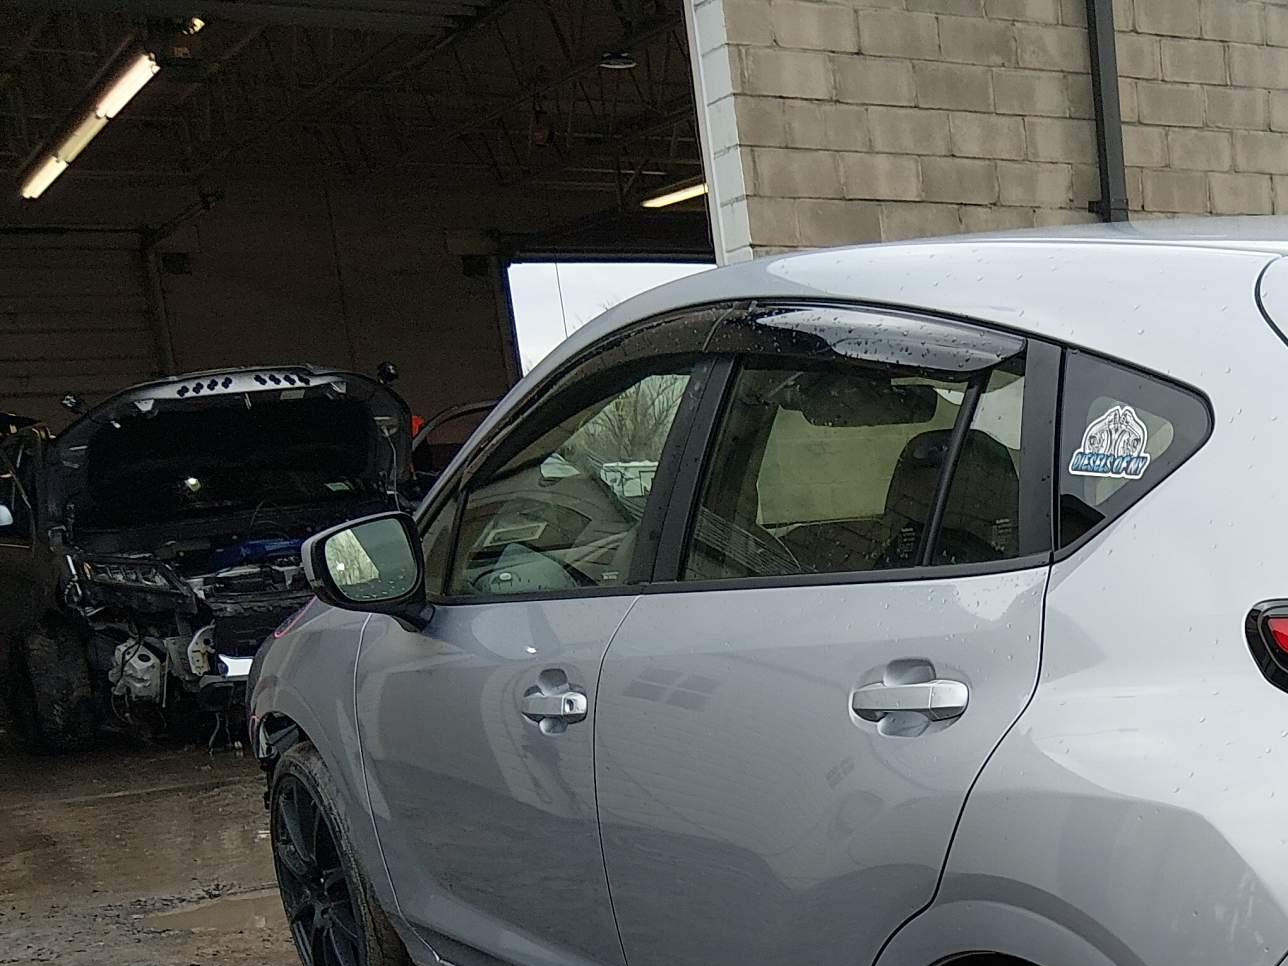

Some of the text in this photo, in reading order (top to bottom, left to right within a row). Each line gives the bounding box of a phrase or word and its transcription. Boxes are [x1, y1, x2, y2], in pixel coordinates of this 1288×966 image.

[1072, 452, 1147, 475] DIESELS OF NY
